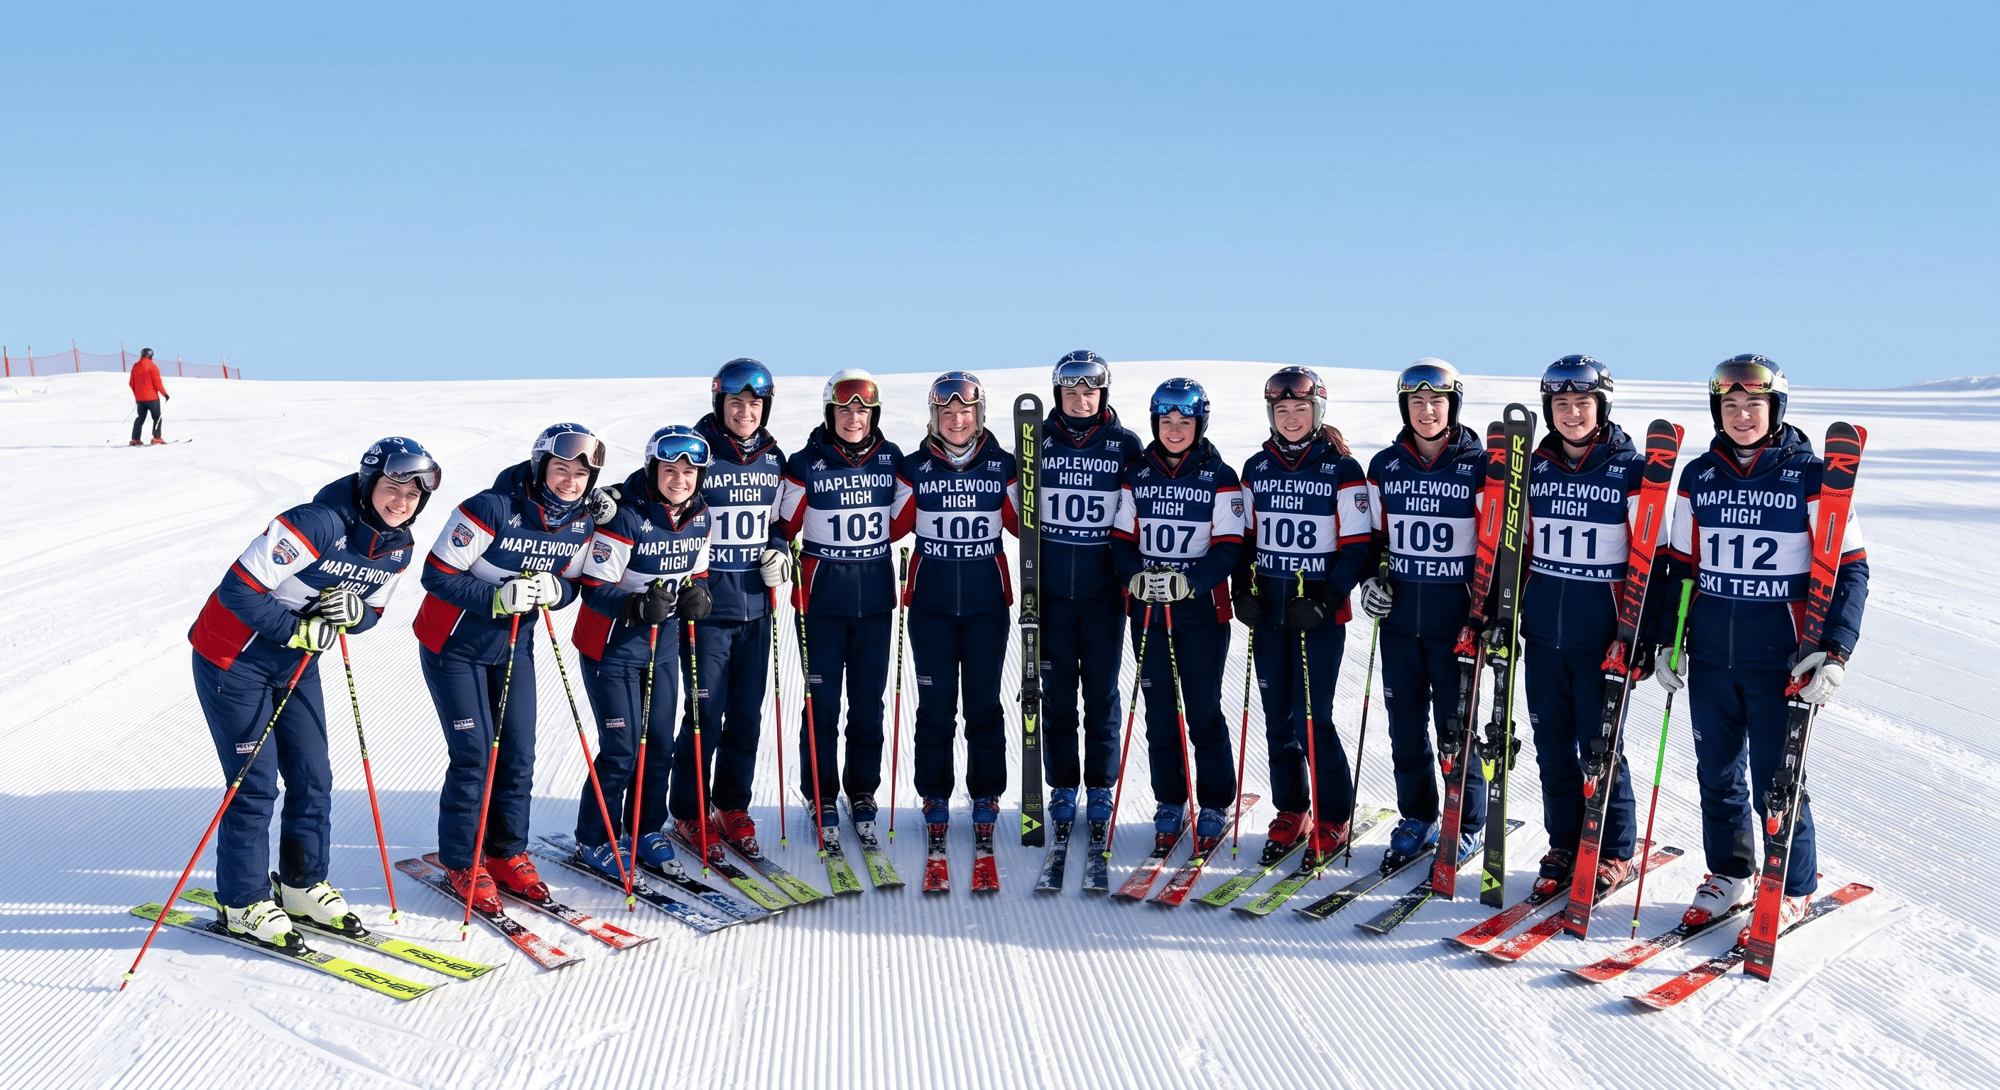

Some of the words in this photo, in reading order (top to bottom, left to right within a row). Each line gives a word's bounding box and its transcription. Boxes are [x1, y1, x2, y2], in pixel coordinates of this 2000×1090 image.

[1041, 457, 1119, 474] MAPLEWOOD
[702, 472, 779, 489] MAPLEWOOD
[813, 474, 893, 493] MAPLEWOOD
[1022, 422, 1035, 530] FISCHER
[1058, 472, 1093, 487] HIGH
[729, 488, 761, 502] HIGH
[919, 479, 1001, 495] MAPLEWOOD
[1135, 486, 1211, 503] MAPLEWOOD
[1253, 479, 1332, 497] MAPLEWOOD
[1384, 480, 1470, 499] MAPLEWOOD
[1504, 434, 1525, 552] FISCHER
[1530, 482, 1621, 504] MAPLEWOOD
[840, 490, 872, 505] HIGH
[942, 494, 976, 508] HIGH
[1271, 495, 1303, 510] HIGH
[1405, 497, 1440, 513] HIGH
[1696, 489, 1797, 510] MAPLEWOOD
[1047, 493, 1105, 524] 105
[1152, 501, 1184, 516] HIGH
[1551, 499, 1588, 517] HIGH
[1720, 508, 1762, 525] HIGH
[715, 510, 766, 540] 101
[827, 511, 883, 542] 103
[932, 516, 990, 539] 106
[1261, 517, 1317, 549] 108
[1142, 523, 1197, 554] 107
[1394, 520, 1454, 553] 109
[1539, 523, 1597, 559] 111
[500, 537, 580, 557] MAPLEWOOD
[637, 537, 707, 556] MAPLEWOOD
[708, 547, 734, 563] SKI
[739, 545, 767, 563] TEA
[820, 547, 846, 558] SKI
[851, 543, 888, 558] TEAM
[924, 541, 947, 557] SKI
[953, 542, 995, 558] TEAM
[1707, 533, 1779, 571] 112
[520, 556, 555, 571] HIGH
[660, 555, 689, 571] HIGH
[1255, 551, 1273, 569] SKI
[1278, 556, 1325, 572] TEAM
[1388, 555, 1409, 573] SKI
[1414, 560, 1464, 577] TEAM
[1699, 573, 1722, 593] SKI
[1729, 578, 1789, 597] TEAM
